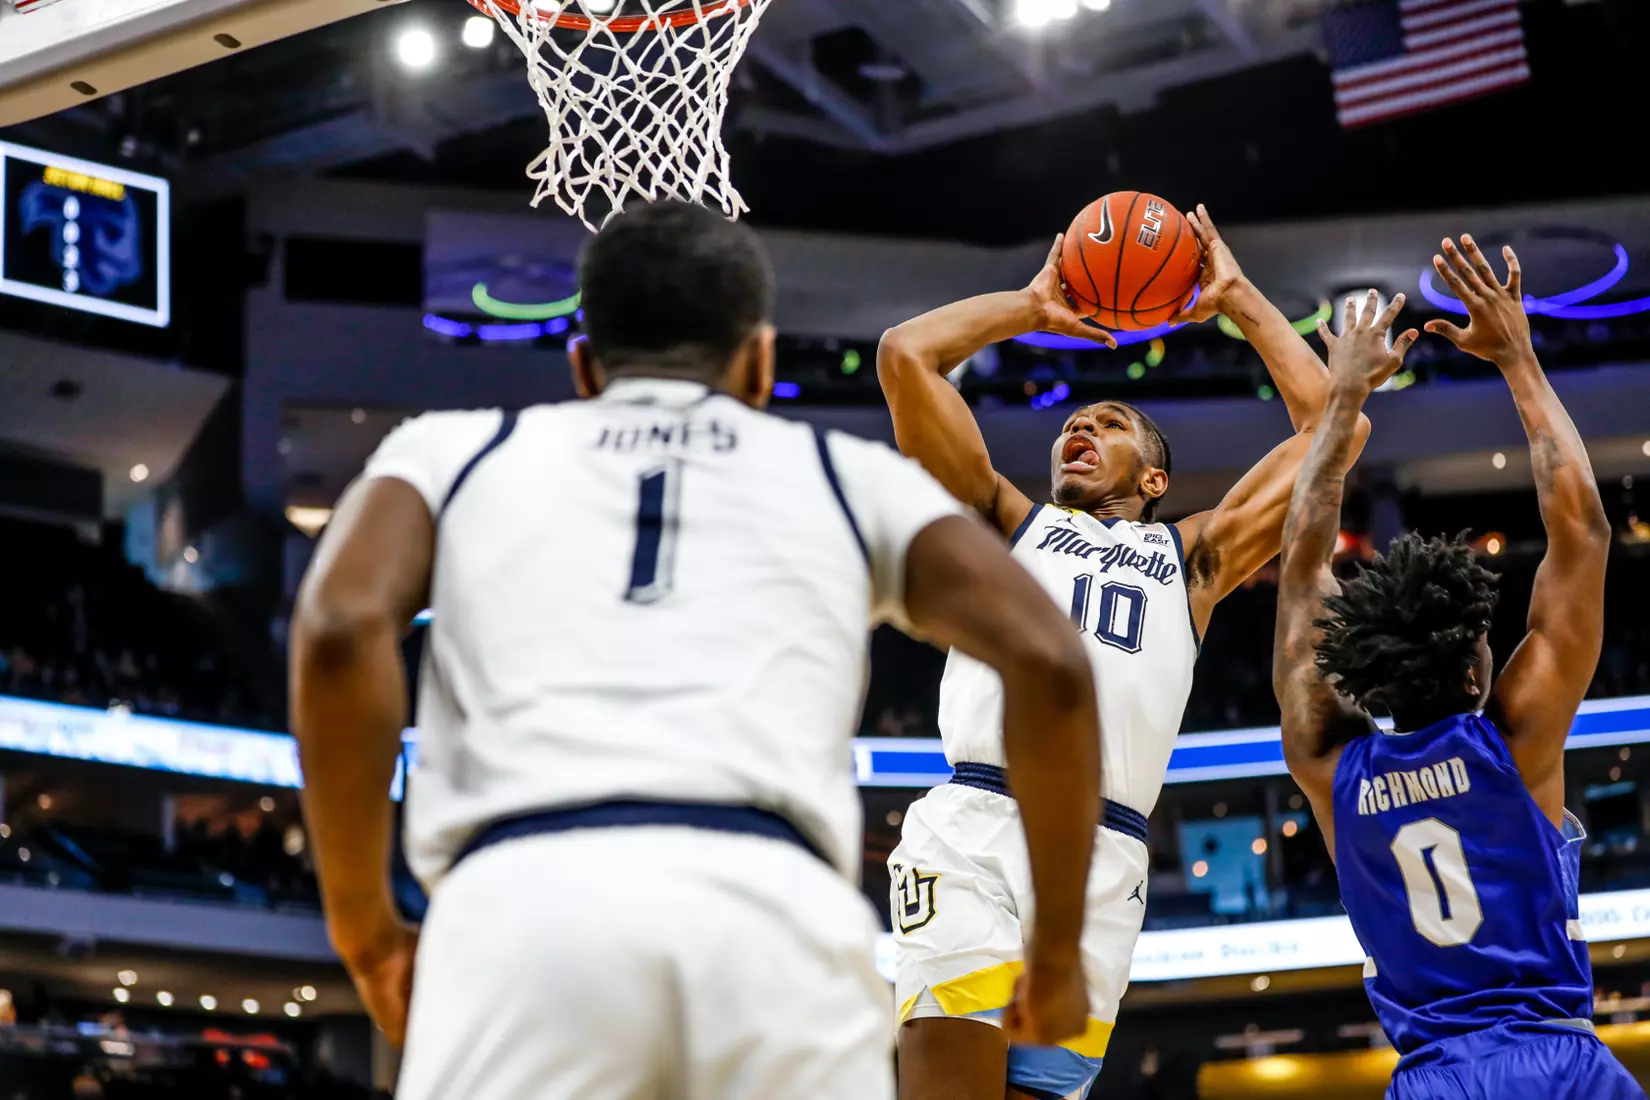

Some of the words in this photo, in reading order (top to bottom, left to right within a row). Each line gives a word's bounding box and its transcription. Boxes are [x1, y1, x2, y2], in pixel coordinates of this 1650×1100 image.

[1136, 199, 1165, 250] ELITE
[596, 418, 738, 453] JONES
[622, 457, 684, 605] 1
[1036, 525, 1177, 586] Marquette
[1143, 536, 1170, 545] EAST
[1070, 573, 1148, 654] 10
[1358, 756, 1471, 815] RICHMOND
[1389, 817, 1484, 947] 0
